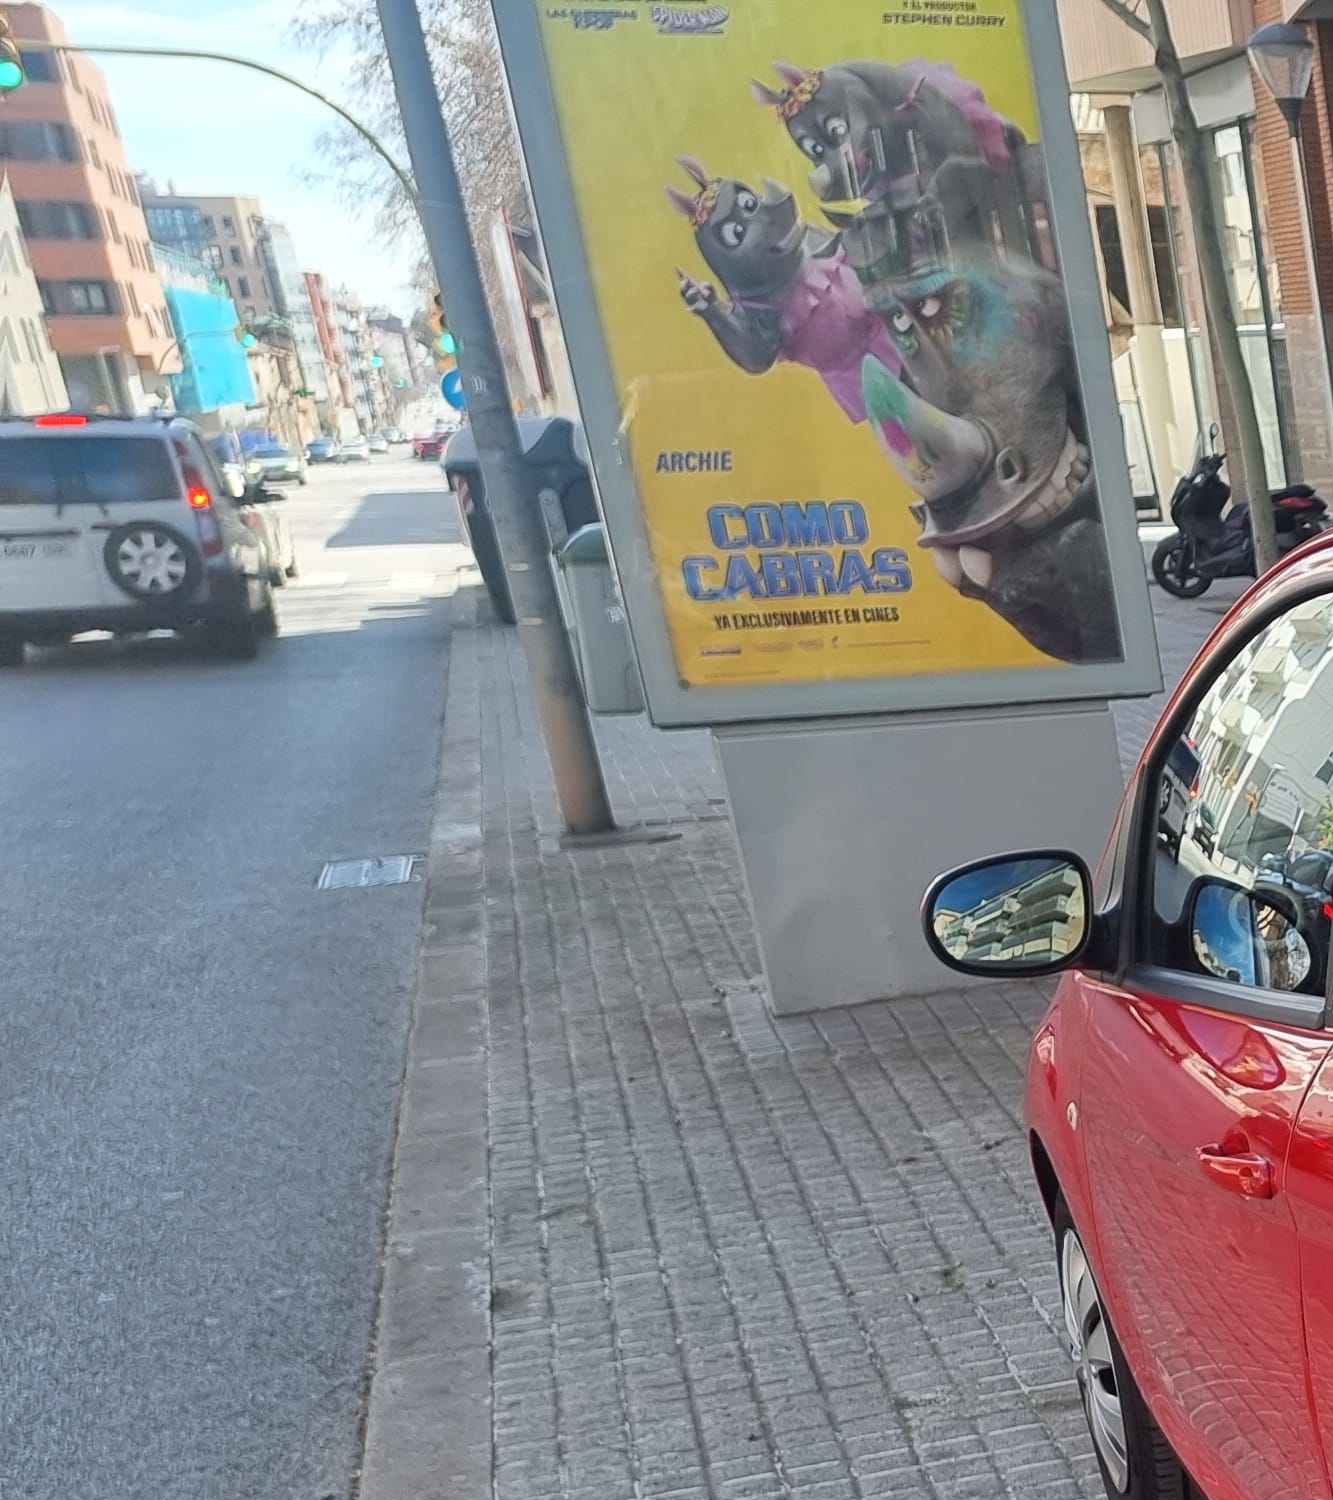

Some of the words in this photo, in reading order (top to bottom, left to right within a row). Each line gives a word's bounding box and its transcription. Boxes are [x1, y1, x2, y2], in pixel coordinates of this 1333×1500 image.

[882, 12, 953, 26] STEPHEN
[956, 14, 1006, 28] CURRY
[656, 450, 733, 473] ARCHIE
[707, 500, 870, 551] COMO
[682, 547, 913, 601] CABRAS
[714, 615, 731, 631] YA
[733, 609, 843, 630] EXCLUSIVAMENTE
[844, 607, 861, 624] EN
[863, 607, 900, 623] CINES
